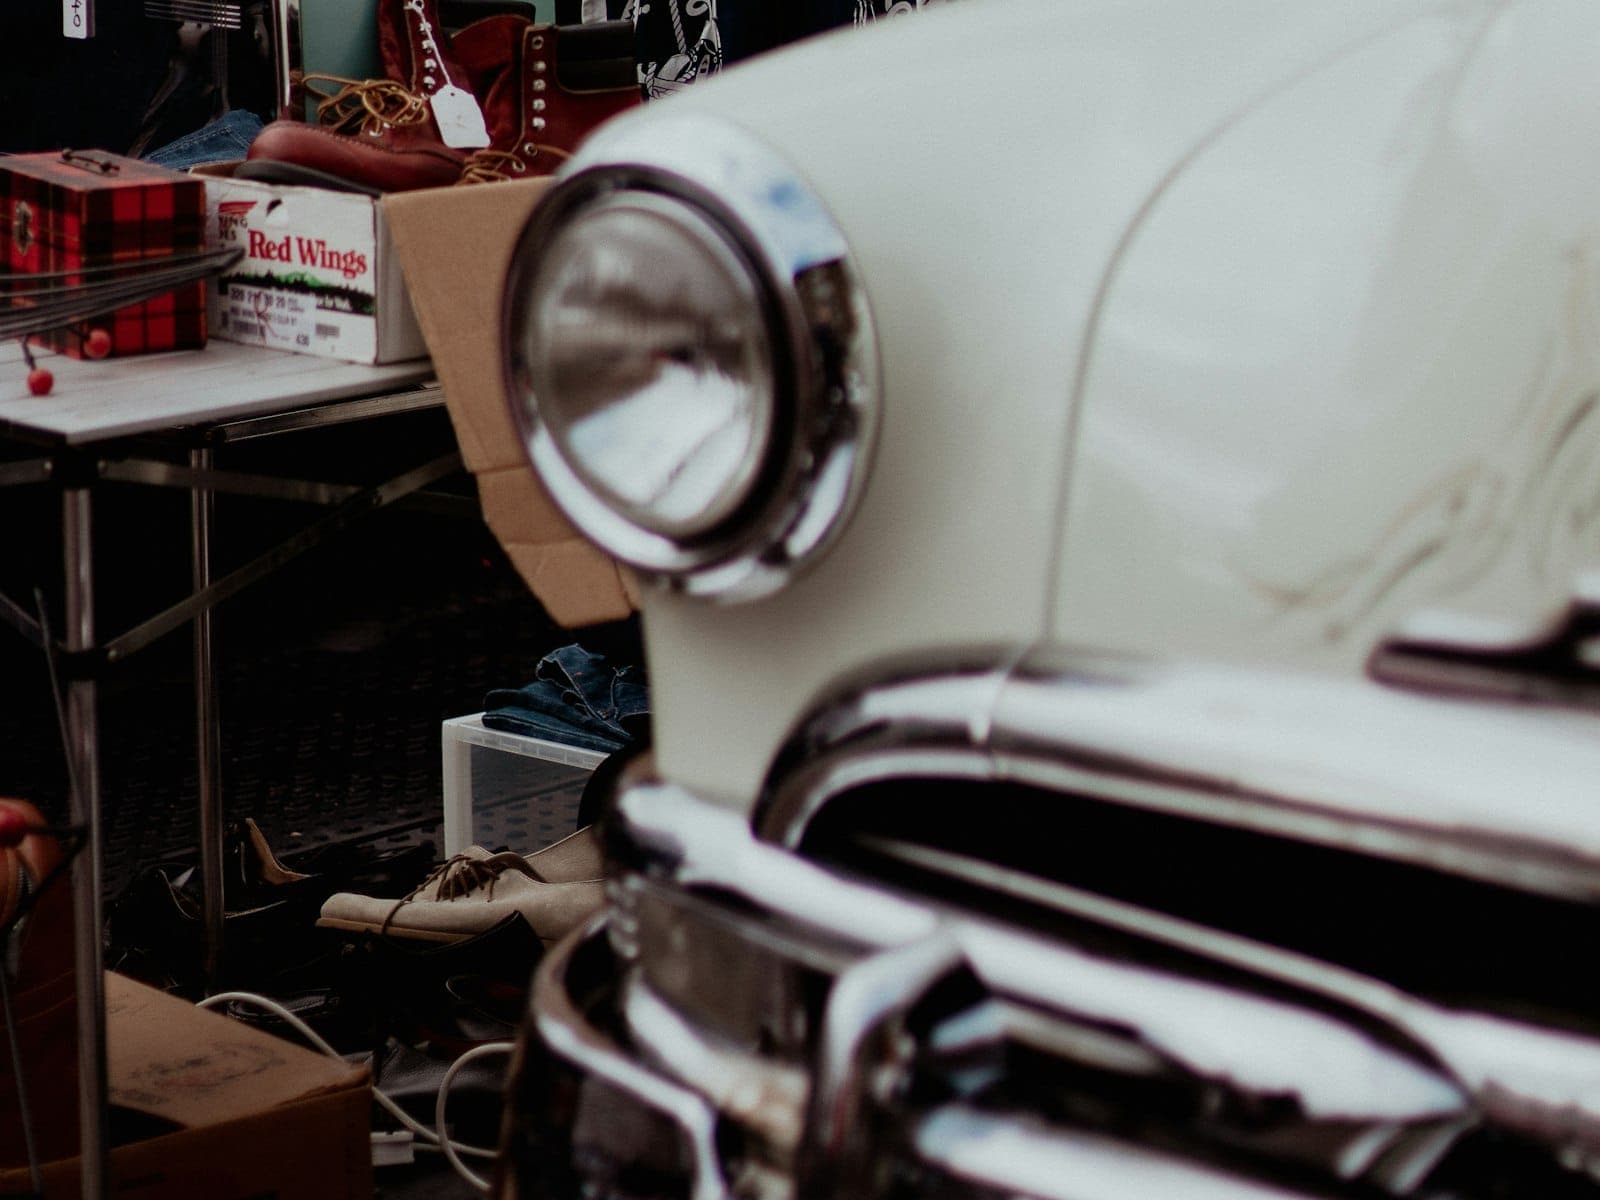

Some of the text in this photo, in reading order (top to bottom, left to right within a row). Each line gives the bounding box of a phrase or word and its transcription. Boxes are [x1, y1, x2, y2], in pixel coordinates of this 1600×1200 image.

[71, 0, 82, 27] 40
[248, 229, 368, 279] Red Wings
